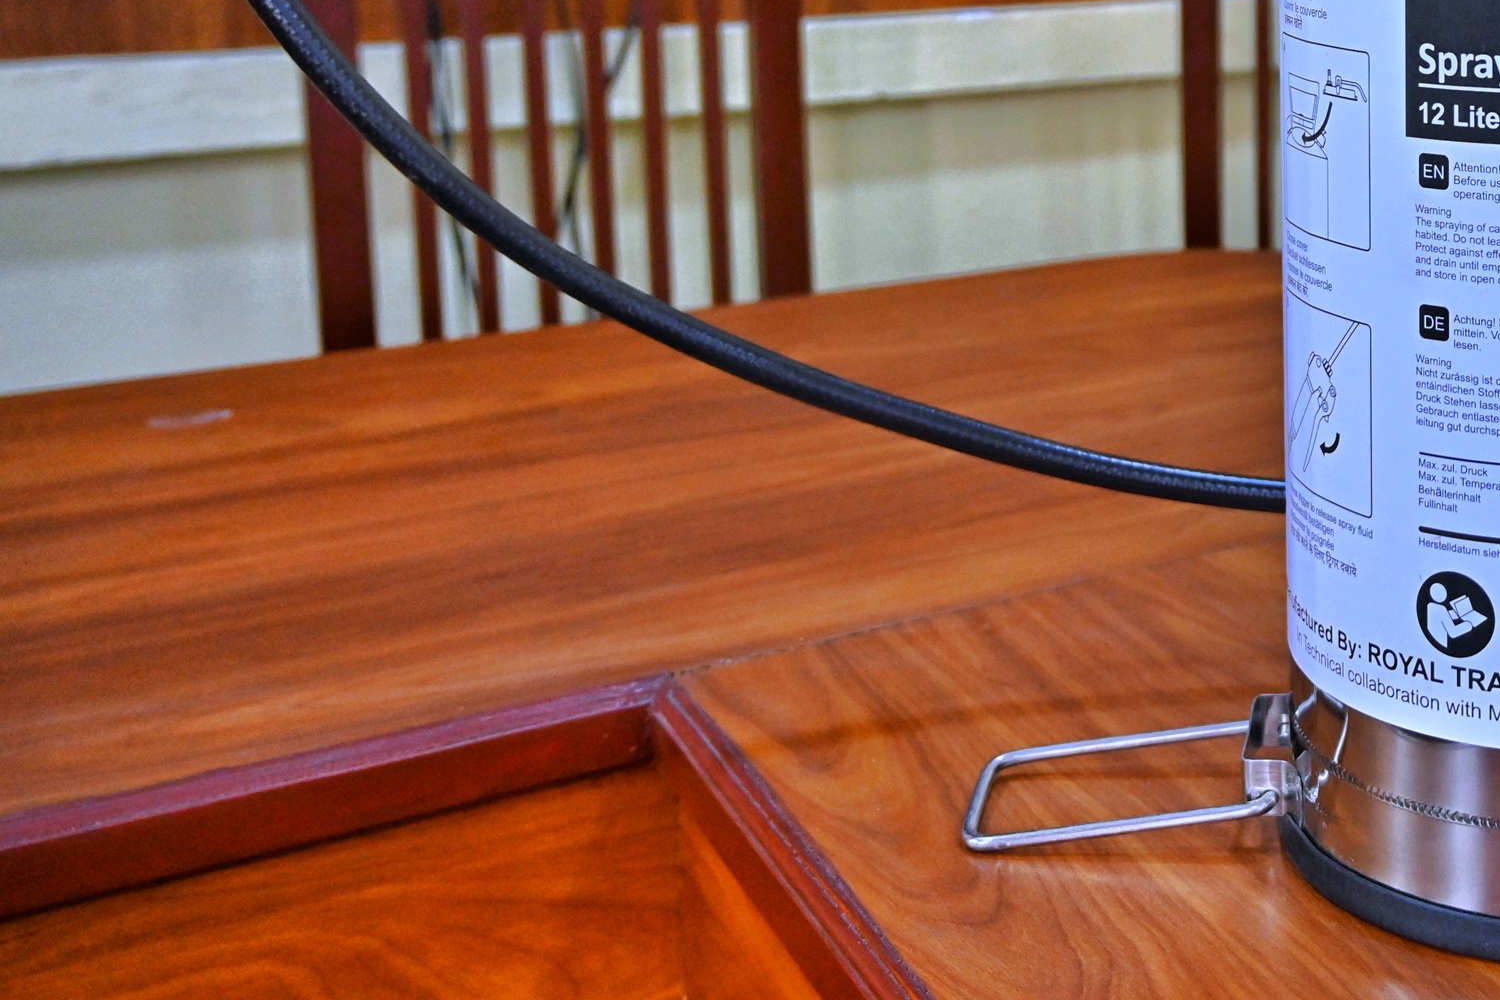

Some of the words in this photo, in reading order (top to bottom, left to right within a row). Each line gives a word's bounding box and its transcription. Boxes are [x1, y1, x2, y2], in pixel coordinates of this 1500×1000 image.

[1418, 102, 1445, 125] 12
[1423, 163, 1445, 180] EN
[1453, 161, 1500, 174] Attention!
[1453, 174, 1487, 187] Before
[1453, 190, 1500, 204] operating
[1415, 203, 1452, 219] Warning
[1415, 216, 1432, 227] The
[1434, 220, 1474, 234] spraying
[1476, 223, 1486, 232] of
[1415, 229, 1450, 242] habited.
[1453, 233, 1467, 244] Do
[1469, 236, 1485, 245] not
[1415, 241, 1447, 255] Protect
[1448, 247, 1484, 258] against
[1415, 268, 1431, 278] and
[1434, 270, 1457, 281] store
[1459, 272, 1468, 282] in
[1470, 275, 1495, 285] open
[1423, 314, 1445, 332] DE
[1453, 314, 1496, 329] Achtung!
[1453, 339, 1481, 351] lesen.
[1418, 457, 1439, 470] Max.
[1441, 463, 1457, 473] zul.
[1460, 464, 1488, 477] Druck
[1418, 470, 1439, 483] Max.
[1441, 476, 1457, 486] zul.
[1418, 484, 1481, 503] Behälterinhalt
[1418, 497, 1458, 513] Fullinhalt
[1418, 537, 1480, 556] Herstelldatum
[1338, 629, 1362, 660] By:
[1368, 642, 1444, 684] ROYAL
[1303, 633, 1344, 677] Technical
[1348, 669, 1440, 711] collaboration
[1445, 699, 1481, 719] with
